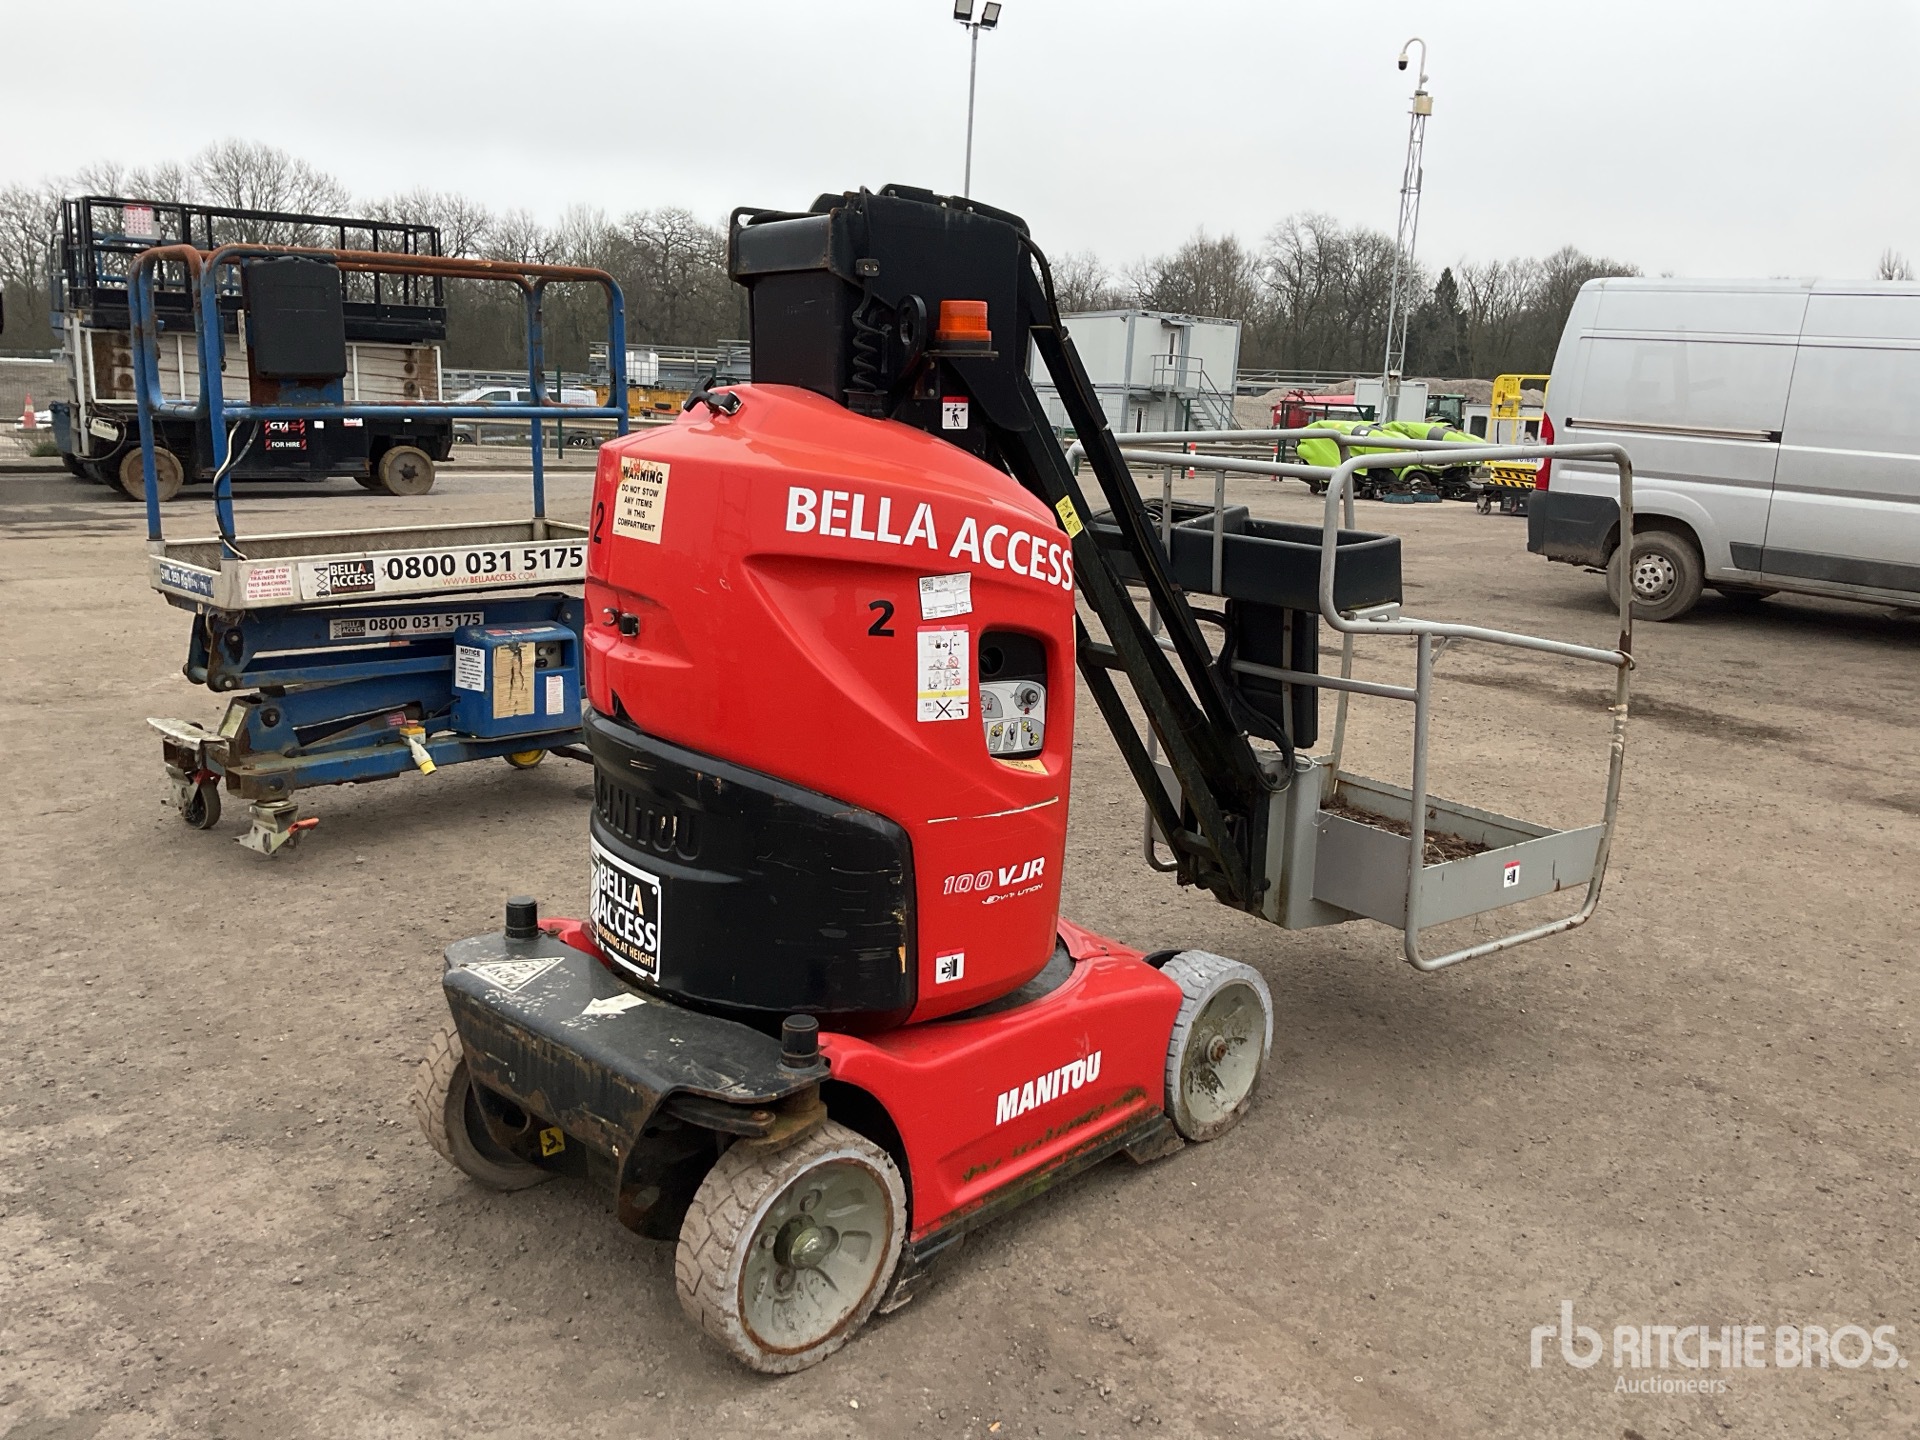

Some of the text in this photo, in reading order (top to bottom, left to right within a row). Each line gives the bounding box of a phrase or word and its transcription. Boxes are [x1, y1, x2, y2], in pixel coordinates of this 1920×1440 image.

[622, 466, 664, 485] WARNING
[621, 483, 660, 498] DO NOT STOW
[624, 495, 653, 508] ANY ITEMS
[593, 501, 605, 545] 2
[617, 517, 656, 532] COMPARTMENT
[633, 509, 646, 519] THIS
[785, 486, 1073, 591] BELLA ACCESS
[330, 563, 367, 576] BELLA
[387, 547, 583, 580] 0800 031 5175
[331, 573, 374, 587] ACCESS
[369, 613, 481, 631] 0800 031 5175
[867, 599, 895, 637] 2
[460, 647, 481, 657] NOTICE
[943, 856, 1046, 895] 100 VJR
[599, 862, 645, 916] BELLA
[598, 898, 657, 952] ACCESS
[598, 924, 656, 969] WORKING AT HEIGHT
[995, 1050, 1102, 1127] MANITOU
